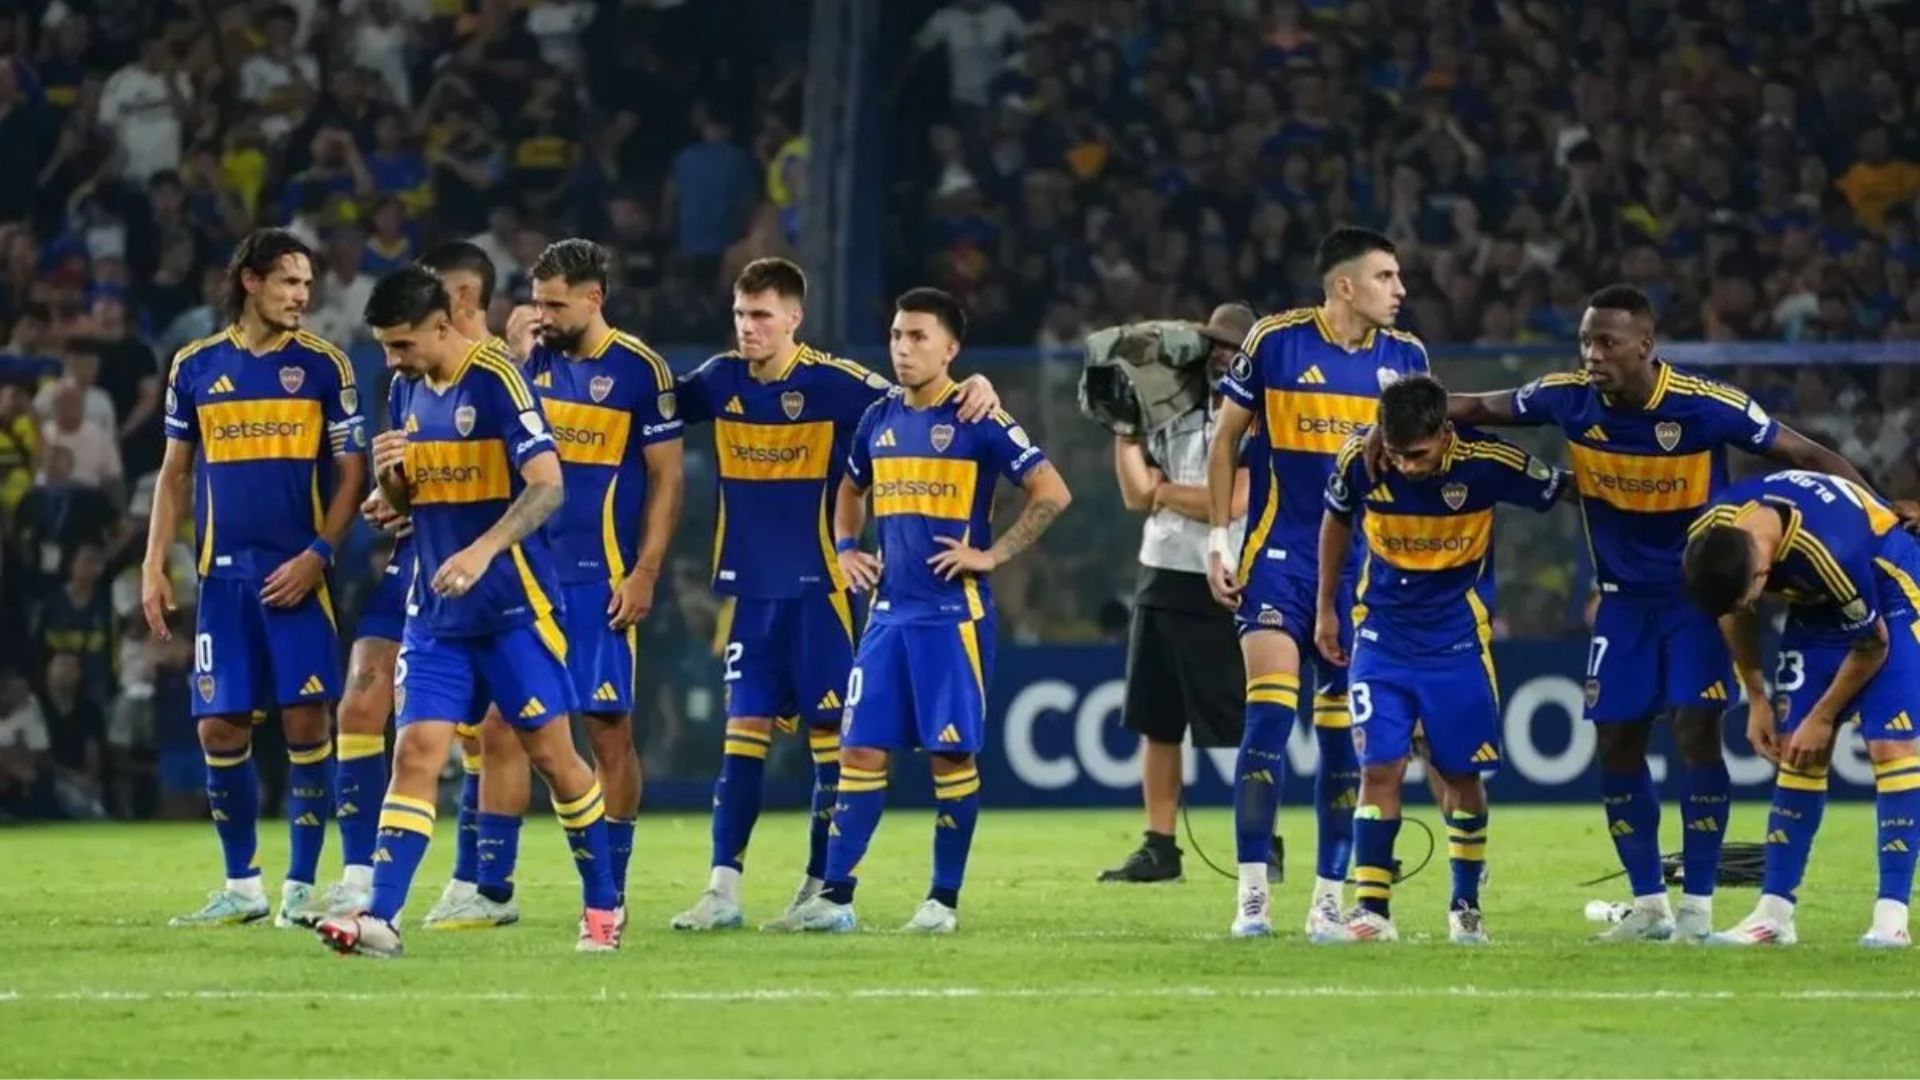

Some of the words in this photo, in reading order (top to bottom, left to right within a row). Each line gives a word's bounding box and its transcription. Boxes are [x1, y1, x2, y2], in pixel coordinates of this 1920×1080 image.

[553, 424, 606, 447] sson
[1296, 412, 1373, 436] bets
[412, 464, 482, 484] etsson
[873, 477, 958, 498] betsson
[723, 643, 743, 681] 2
[1587, 636, 1608, 677] 17
[1776, 650, 1805, 691] 23
[845, 667, 862, 706] 0
